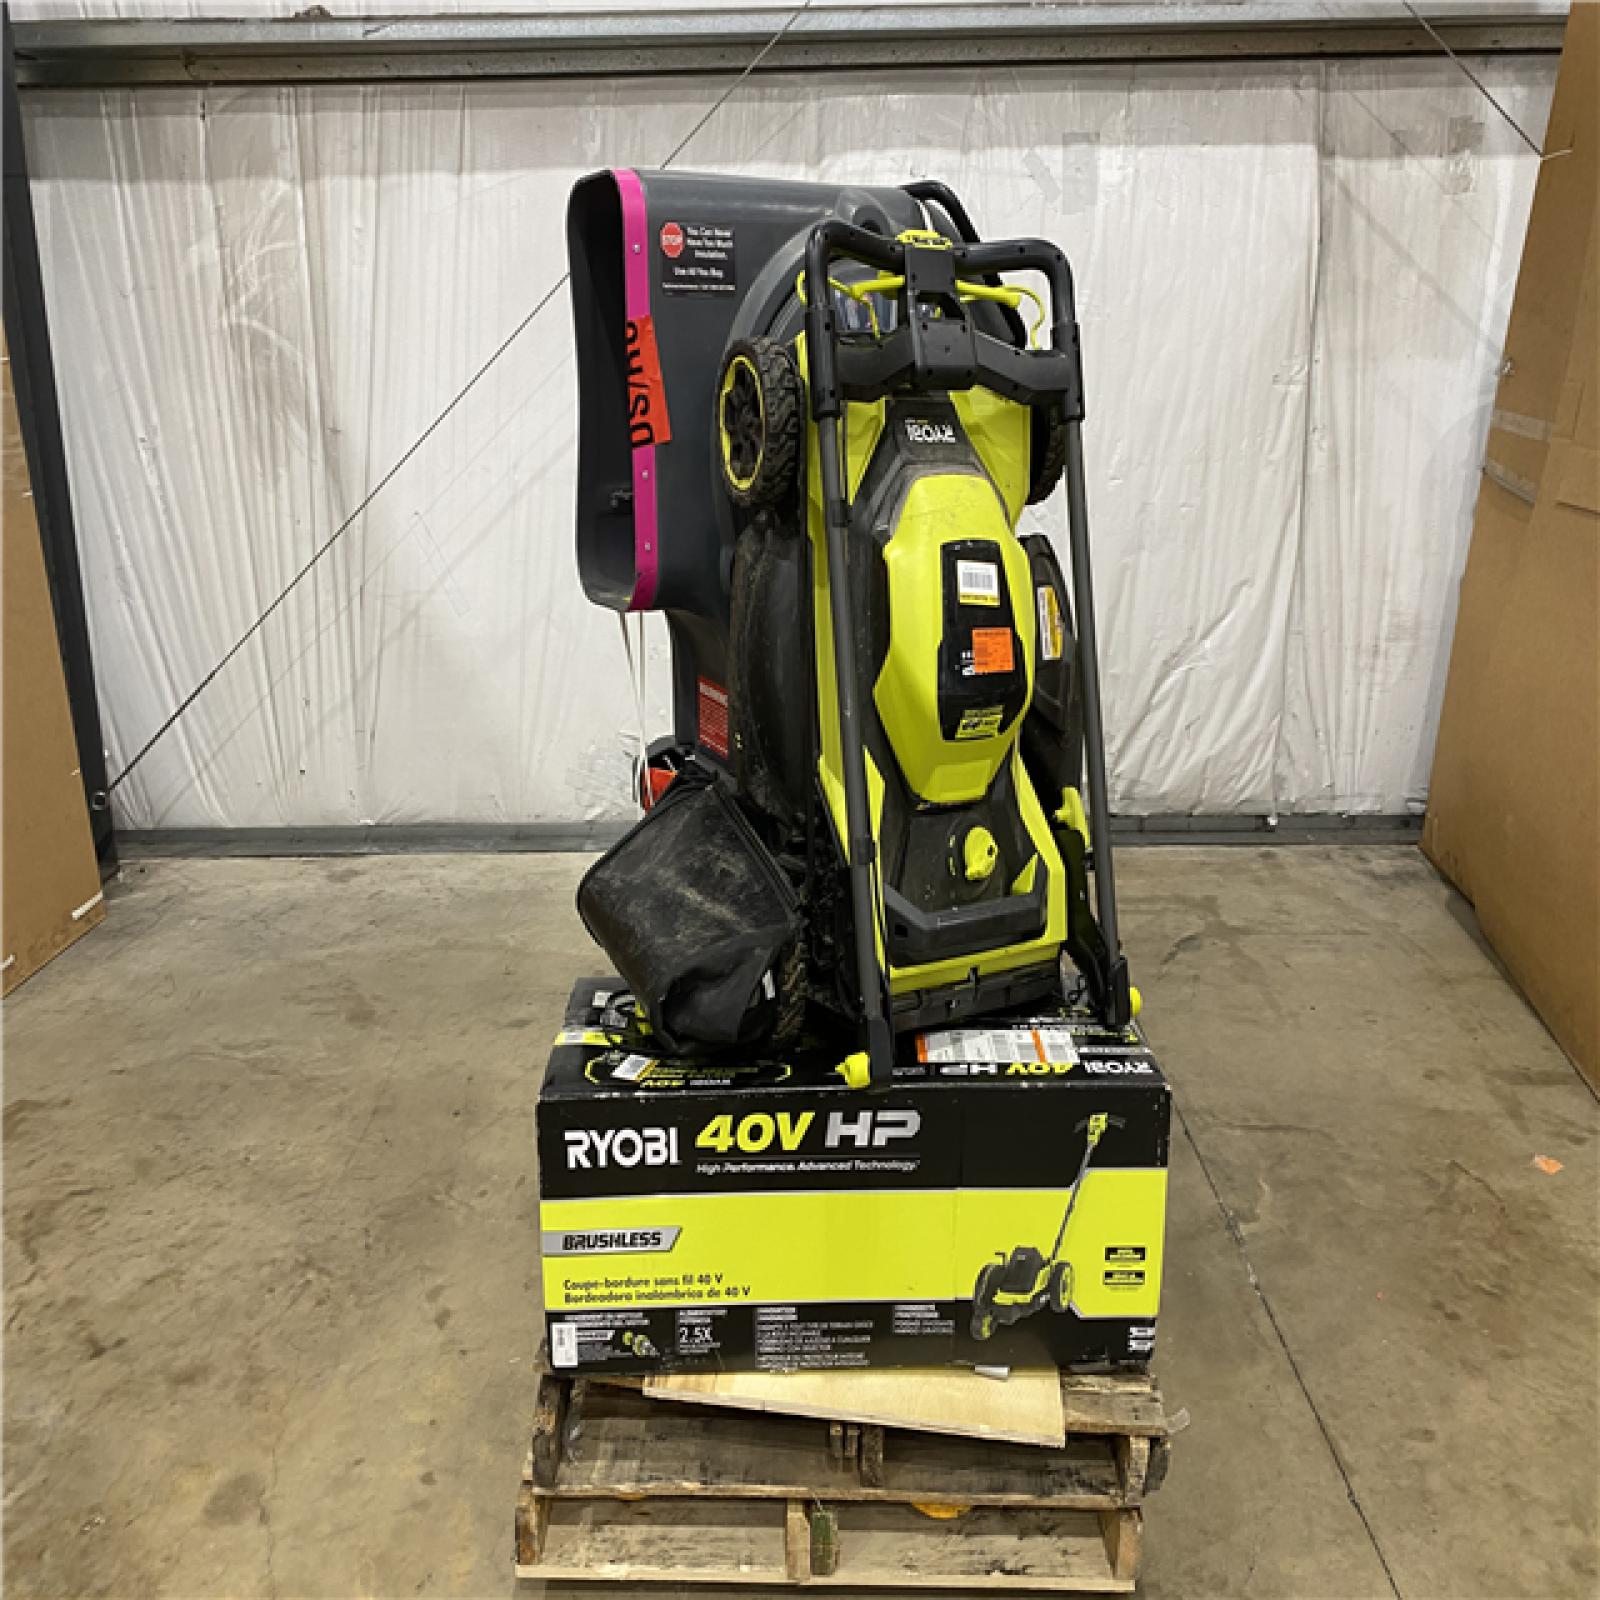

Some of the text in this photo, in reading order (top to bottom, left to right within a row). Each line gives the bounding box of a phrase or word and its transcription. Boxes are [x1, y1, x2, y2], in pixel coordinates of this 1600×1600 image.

[564, 1109, 921, 1170] RYOBI 40V HP
[696, 1161, 721, 1176] High
[796, 1159, 853, 1172] Advanced
[562, 1231, 662, 1251] BRUSHLESS
[563, 1273, 723, 1291] Coupe-bordure sans fil 40 V
[564, 1289, 633, 1304] Bordeadora
[707, 1286, 721, 1298] de
[724, 1285, 739, 1298] 40
[742, 1285, 751, 1297] V
